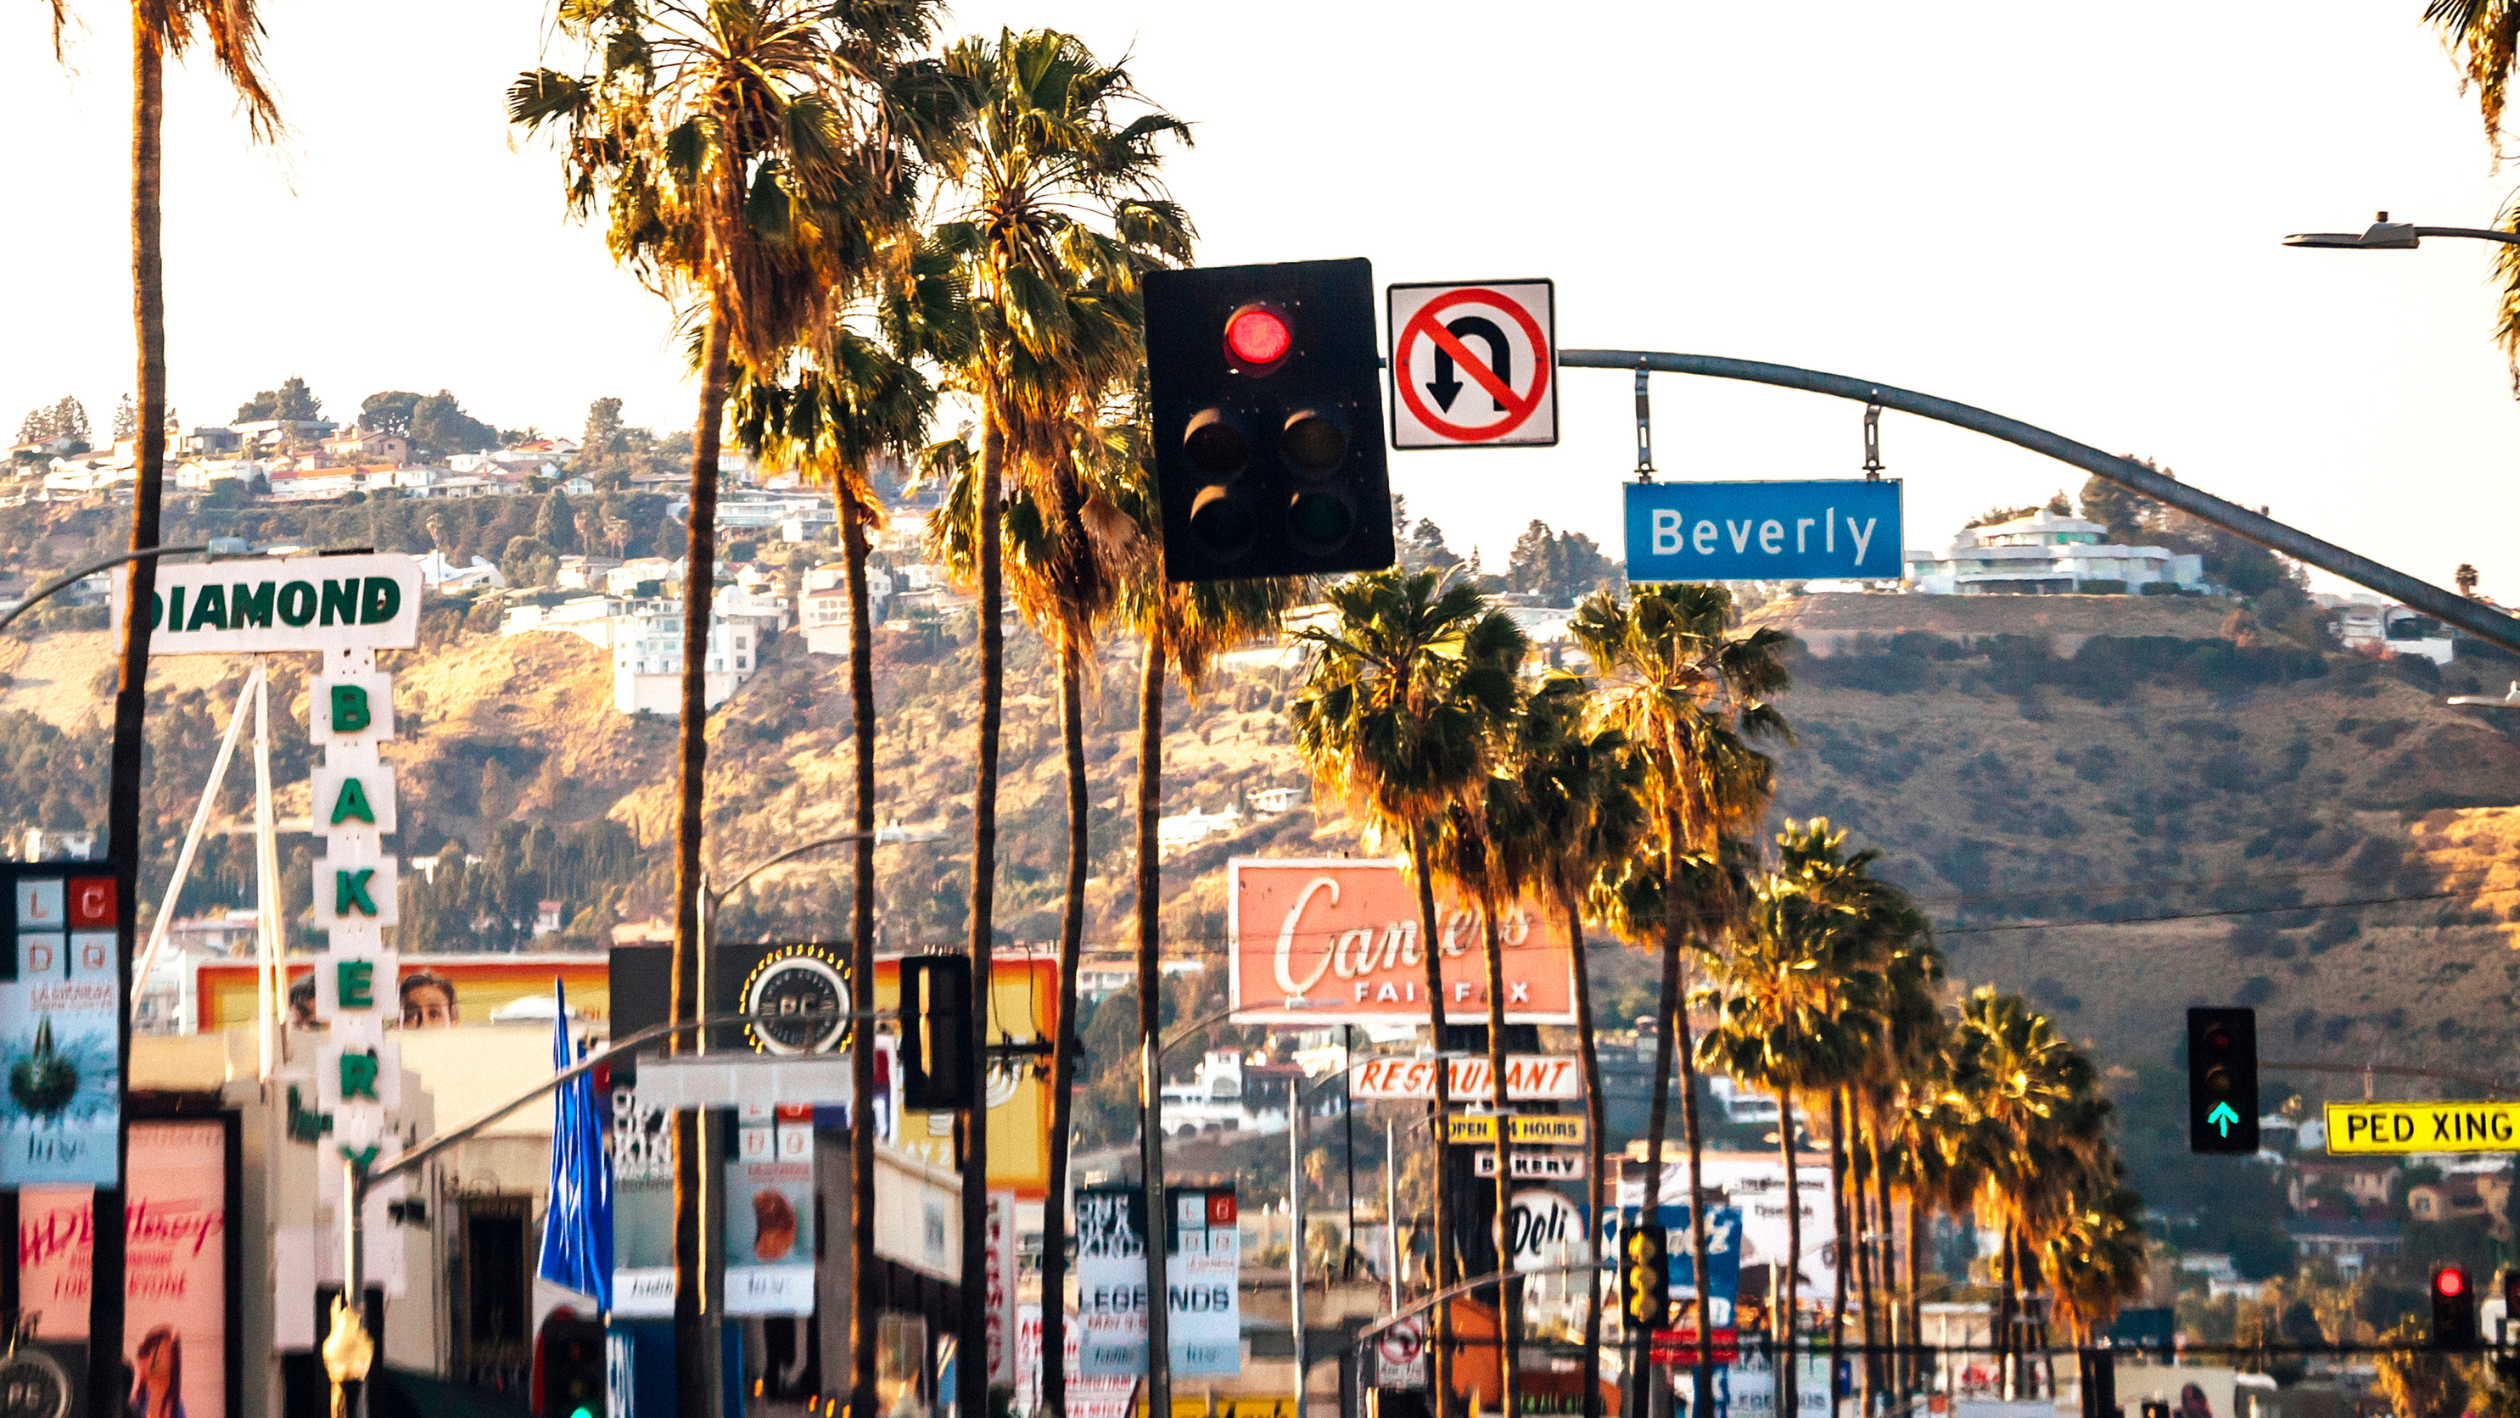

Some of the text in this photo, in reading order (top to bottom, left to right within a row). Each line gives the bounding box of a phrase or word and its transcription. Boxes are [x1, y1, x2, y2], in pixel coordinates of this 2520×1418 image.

[1652, 507, 1877, 566] Beverly
[82, 885, 106, 919] C
[1354, 981, 1530, 1004] FAIFX
[1523, 1121, 1577, 1138] HOURS
[2347, 1111, 2513, 1143] PED XING
[1482, 1157, 1575, 1174] BKERY
[1512, 1201, 1568, 1256] Deli
[1078, 1282, 1230, 1314] LEGENDS
